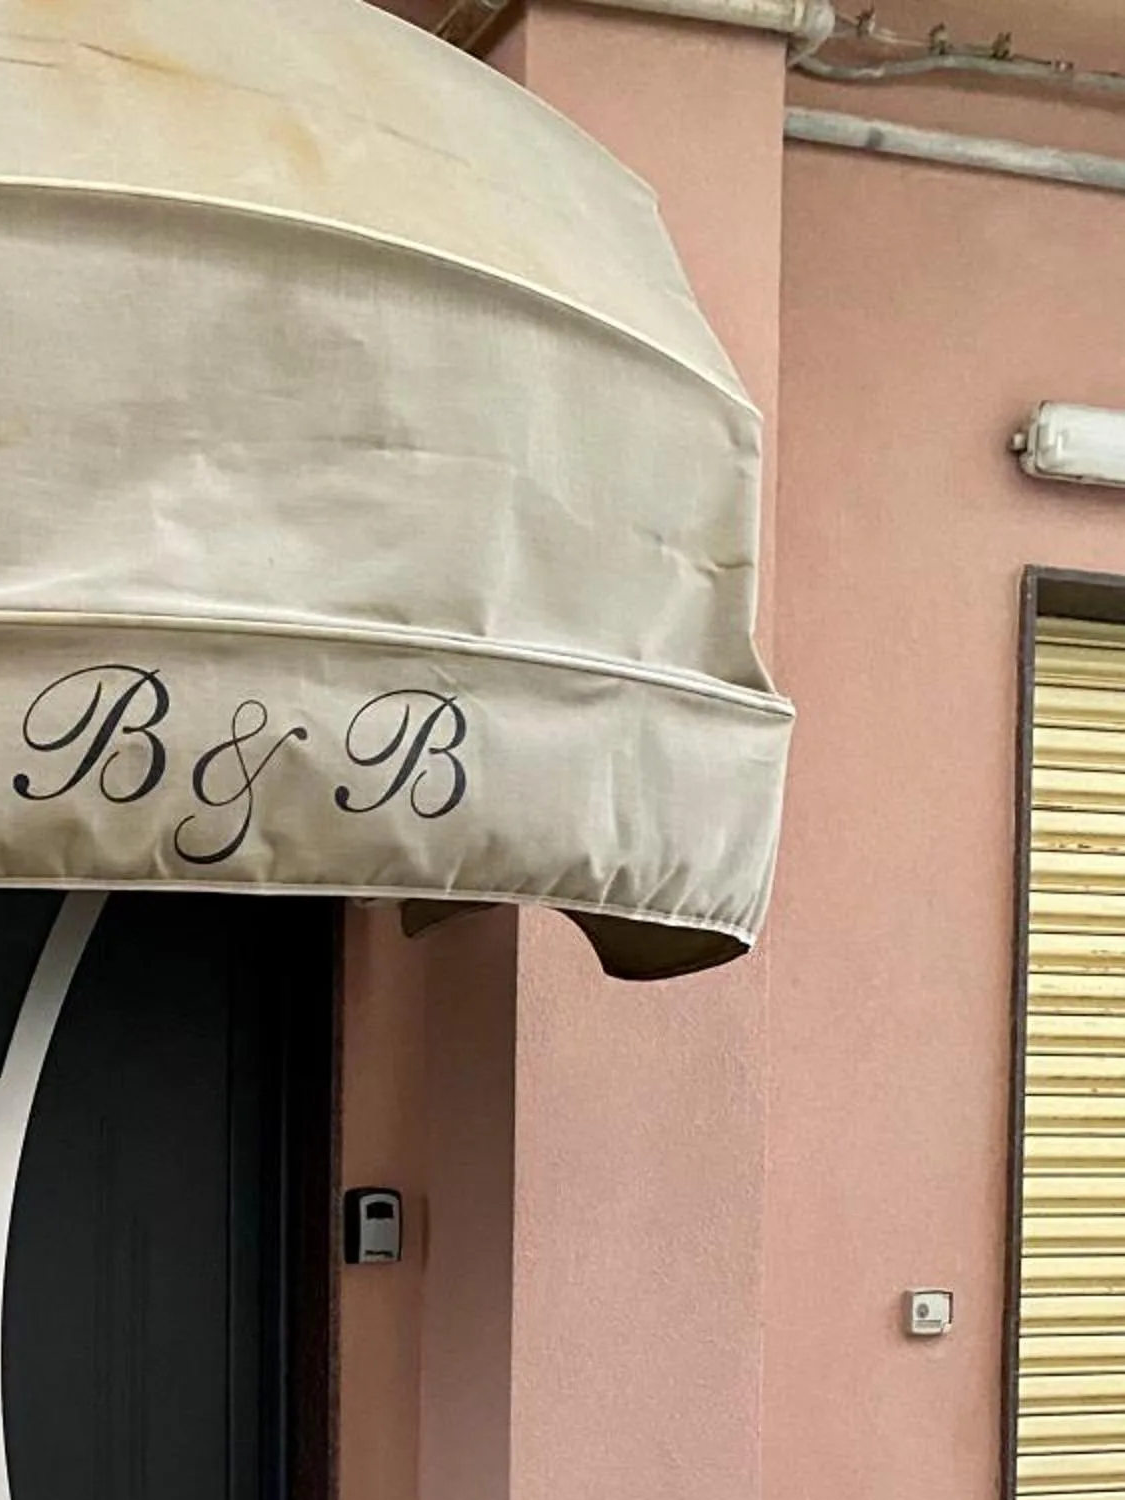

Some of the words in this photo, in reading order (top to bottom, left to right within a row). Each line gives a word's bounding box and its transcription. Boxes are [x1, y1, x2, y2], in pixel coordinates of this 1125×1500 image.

[13, 663, 170, 804] B
[174, 699, 308, 865] &
[334, 688, 468, 819] B
